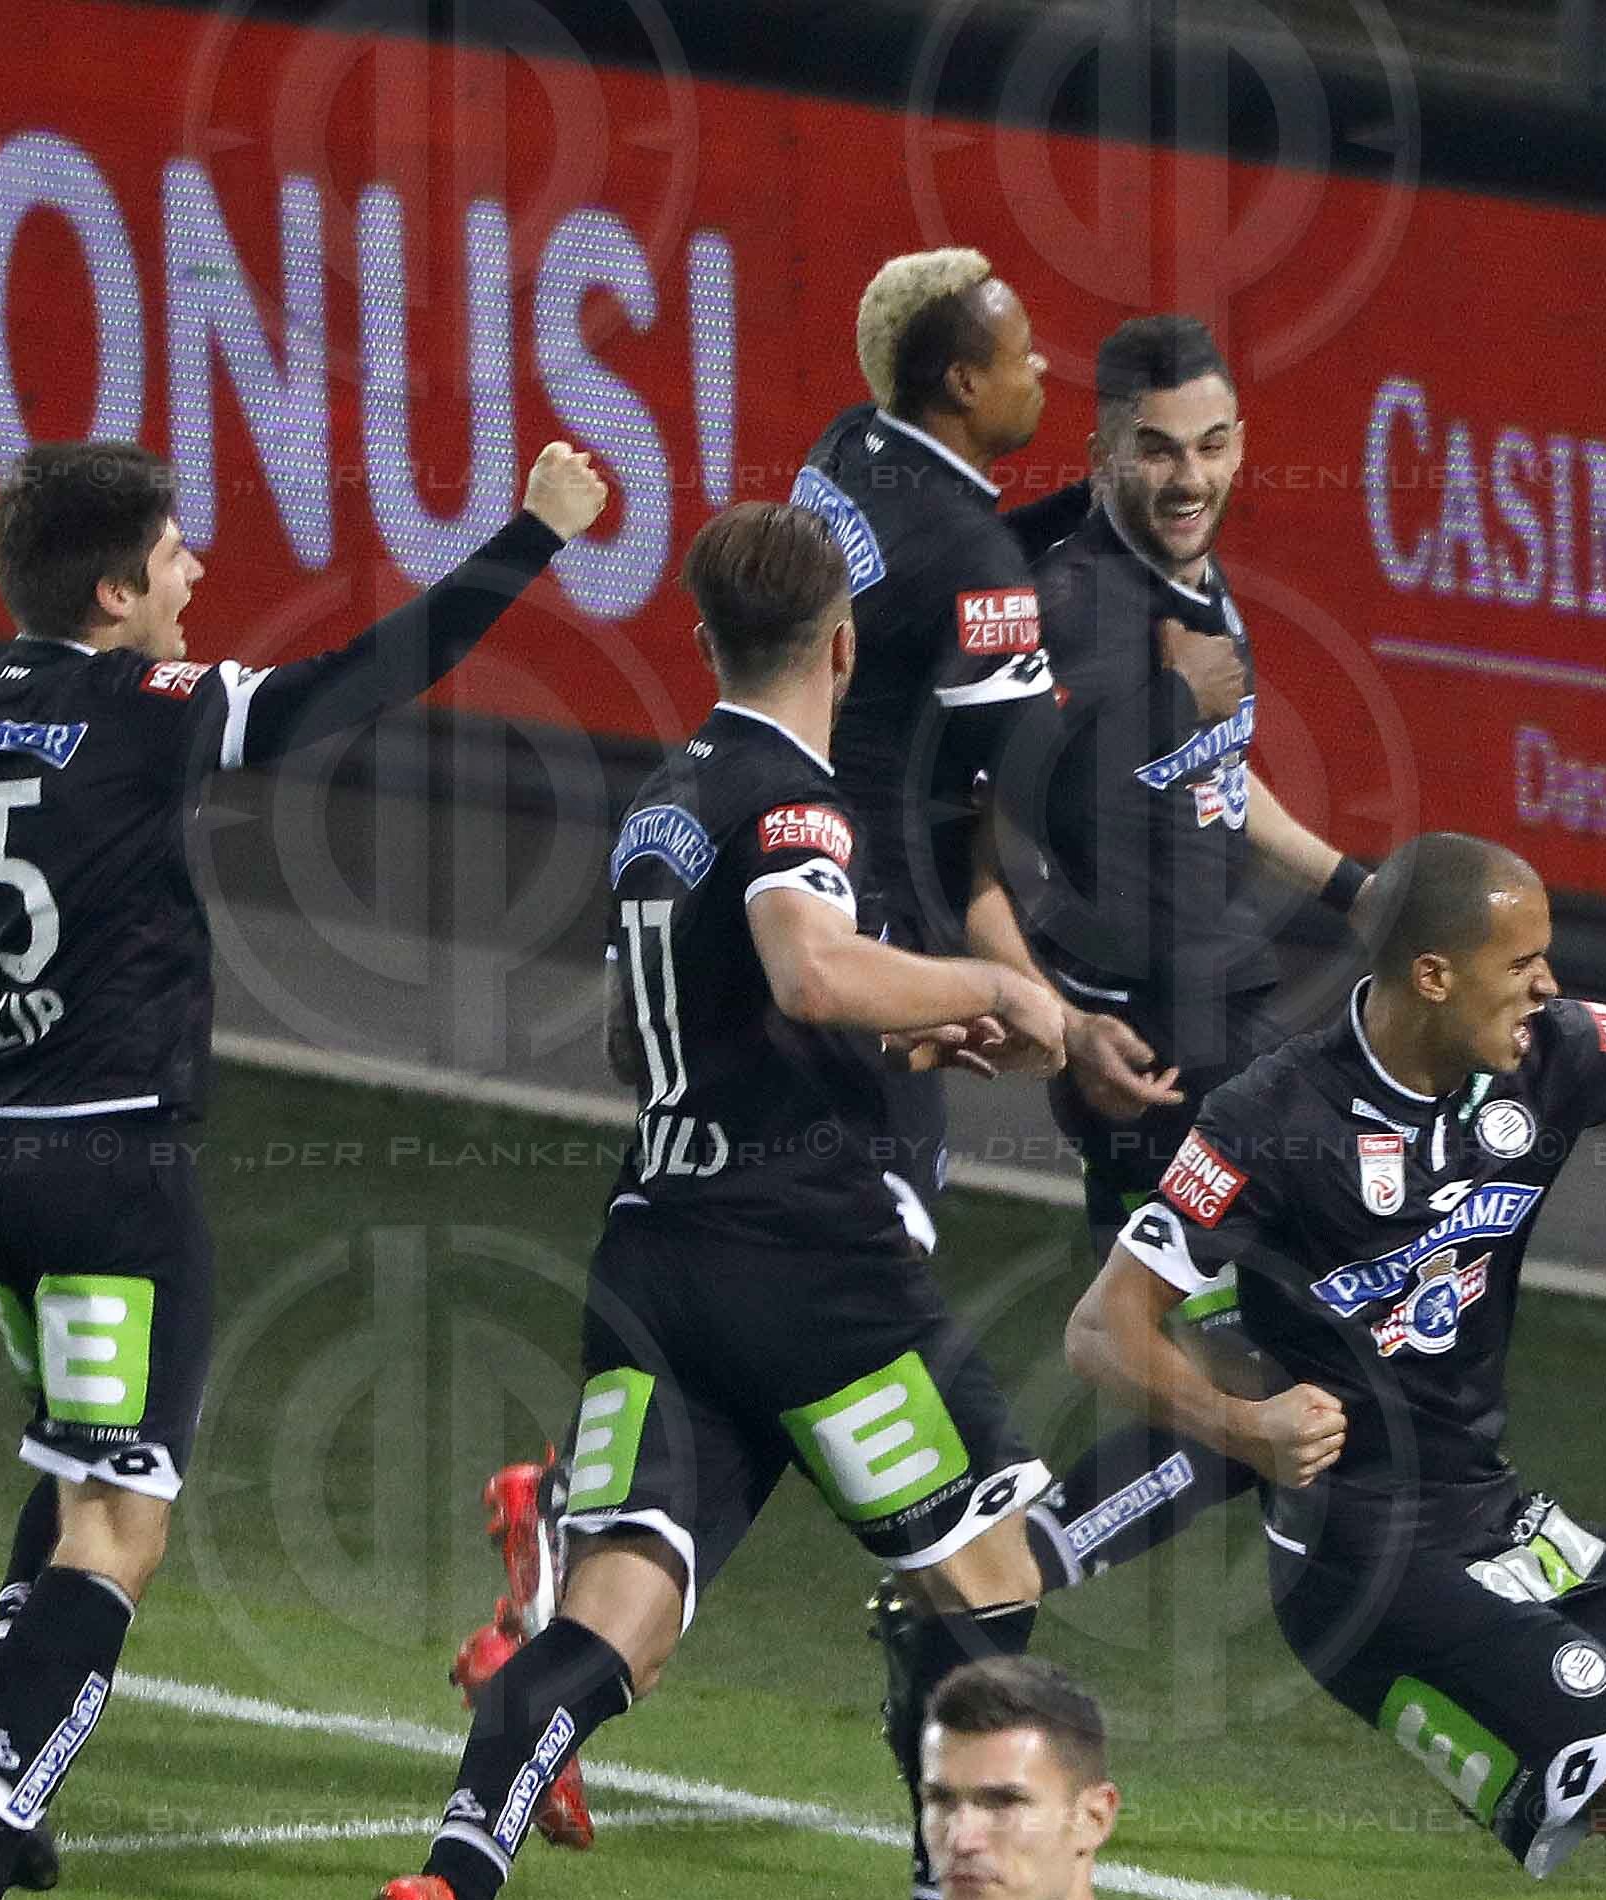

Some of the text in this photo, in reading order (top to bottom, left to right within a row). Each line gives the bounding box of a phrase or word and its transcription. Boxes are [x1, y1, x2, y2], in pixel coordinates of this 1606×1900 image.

[621, 900, 688, 1112] 17
[41, 1294, 128, 1404] E
[811, 1383, 940, 1506] E
